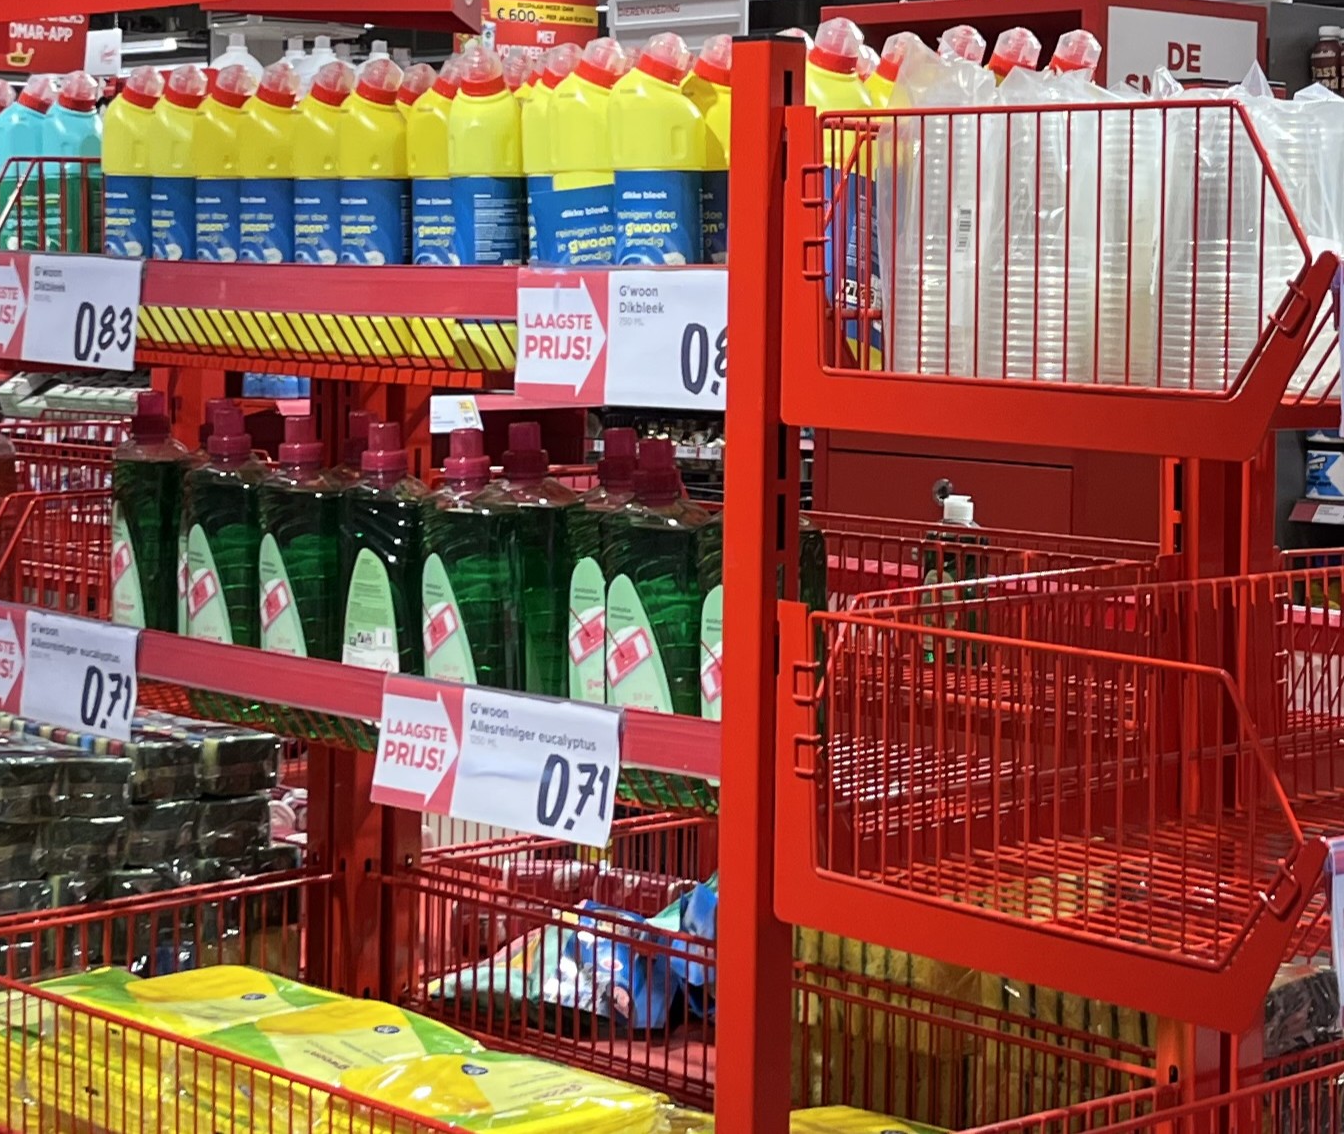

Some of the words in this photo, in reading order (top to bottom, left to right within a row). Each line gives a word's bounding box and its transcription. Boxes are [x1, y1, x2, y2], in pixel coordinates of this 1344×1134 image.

[1167, 41, 1201, 73] DE
[625, 221, 671, 237] gwoon
[619, 285, 659, 297] G'woon
[619, 302, 665, 314] Dikbleek
[73, 301, 133, 364] 0.83
[524, 313, 592, 330] LAAGSTE
[524, 335, 592, 361] PRIJS!
[80, 665, 132, 729] 0.71
[470, 702, 509, 718] G'woon
[386, 718, 448, 743] LAAGSTE
[470, 719, 536, 742] Allesreiniger
[538, 731, 598, 752] eucalyptus
[383, 739, 445, 773] PRIJS!
[537, 753, 611, 831] 0.71
